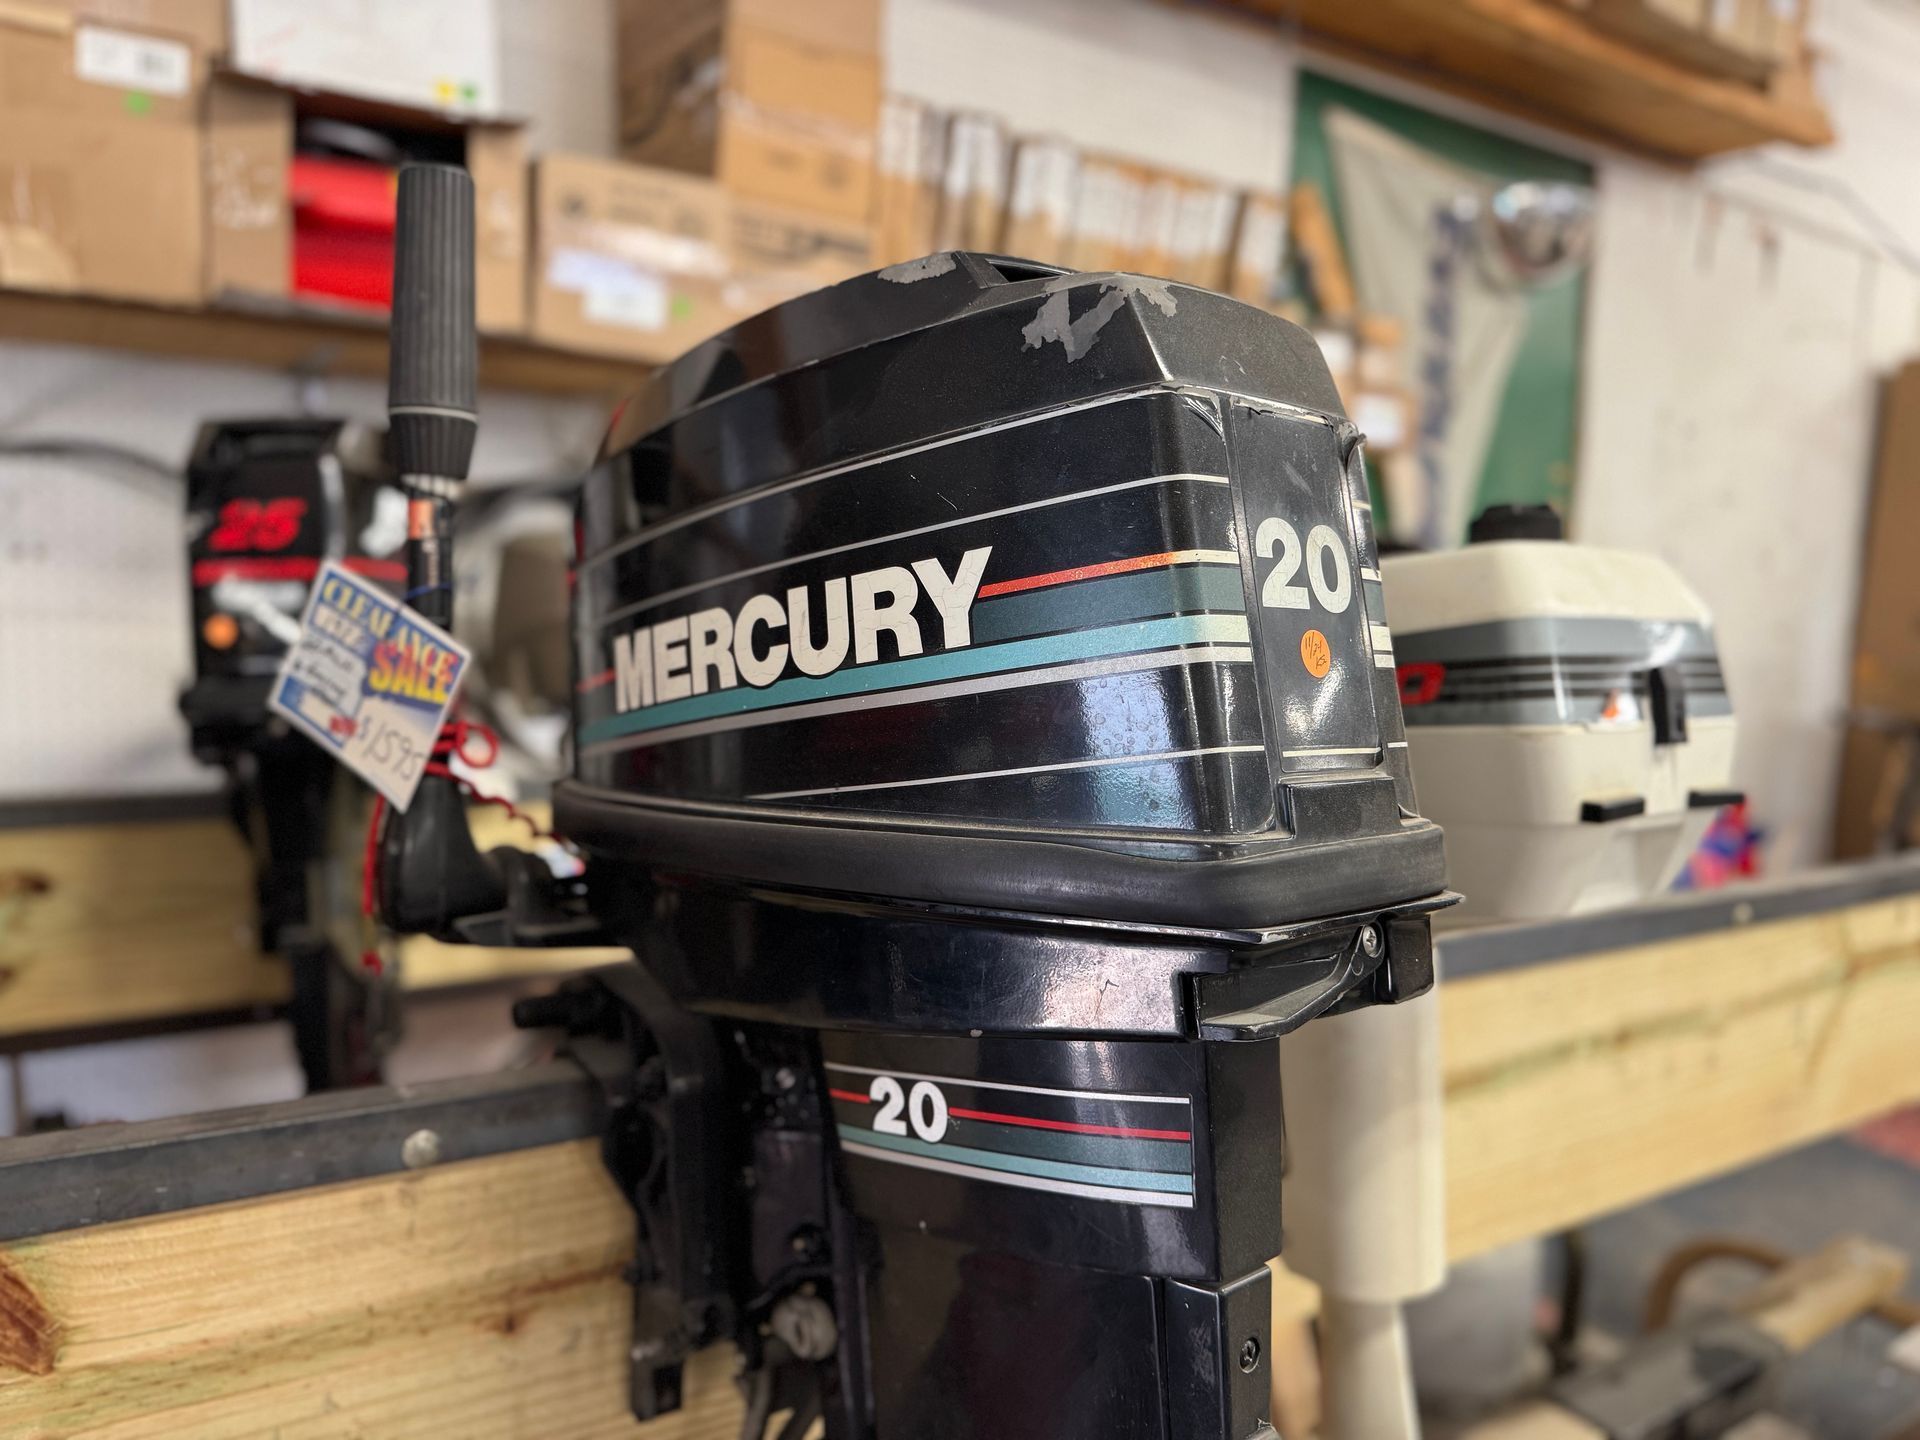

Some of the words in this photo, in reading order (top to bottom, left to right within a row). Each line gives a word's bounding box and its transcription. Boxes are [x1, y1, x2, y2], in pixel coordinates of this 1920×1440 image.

[208, 497, 306, 550] 25
[1255, 516, 1352, 614] 20
[614, 545, 993, 714] MERCURY
[368, 640, 457, 705] SALE
[869, 1076, 948, 1143] 20
